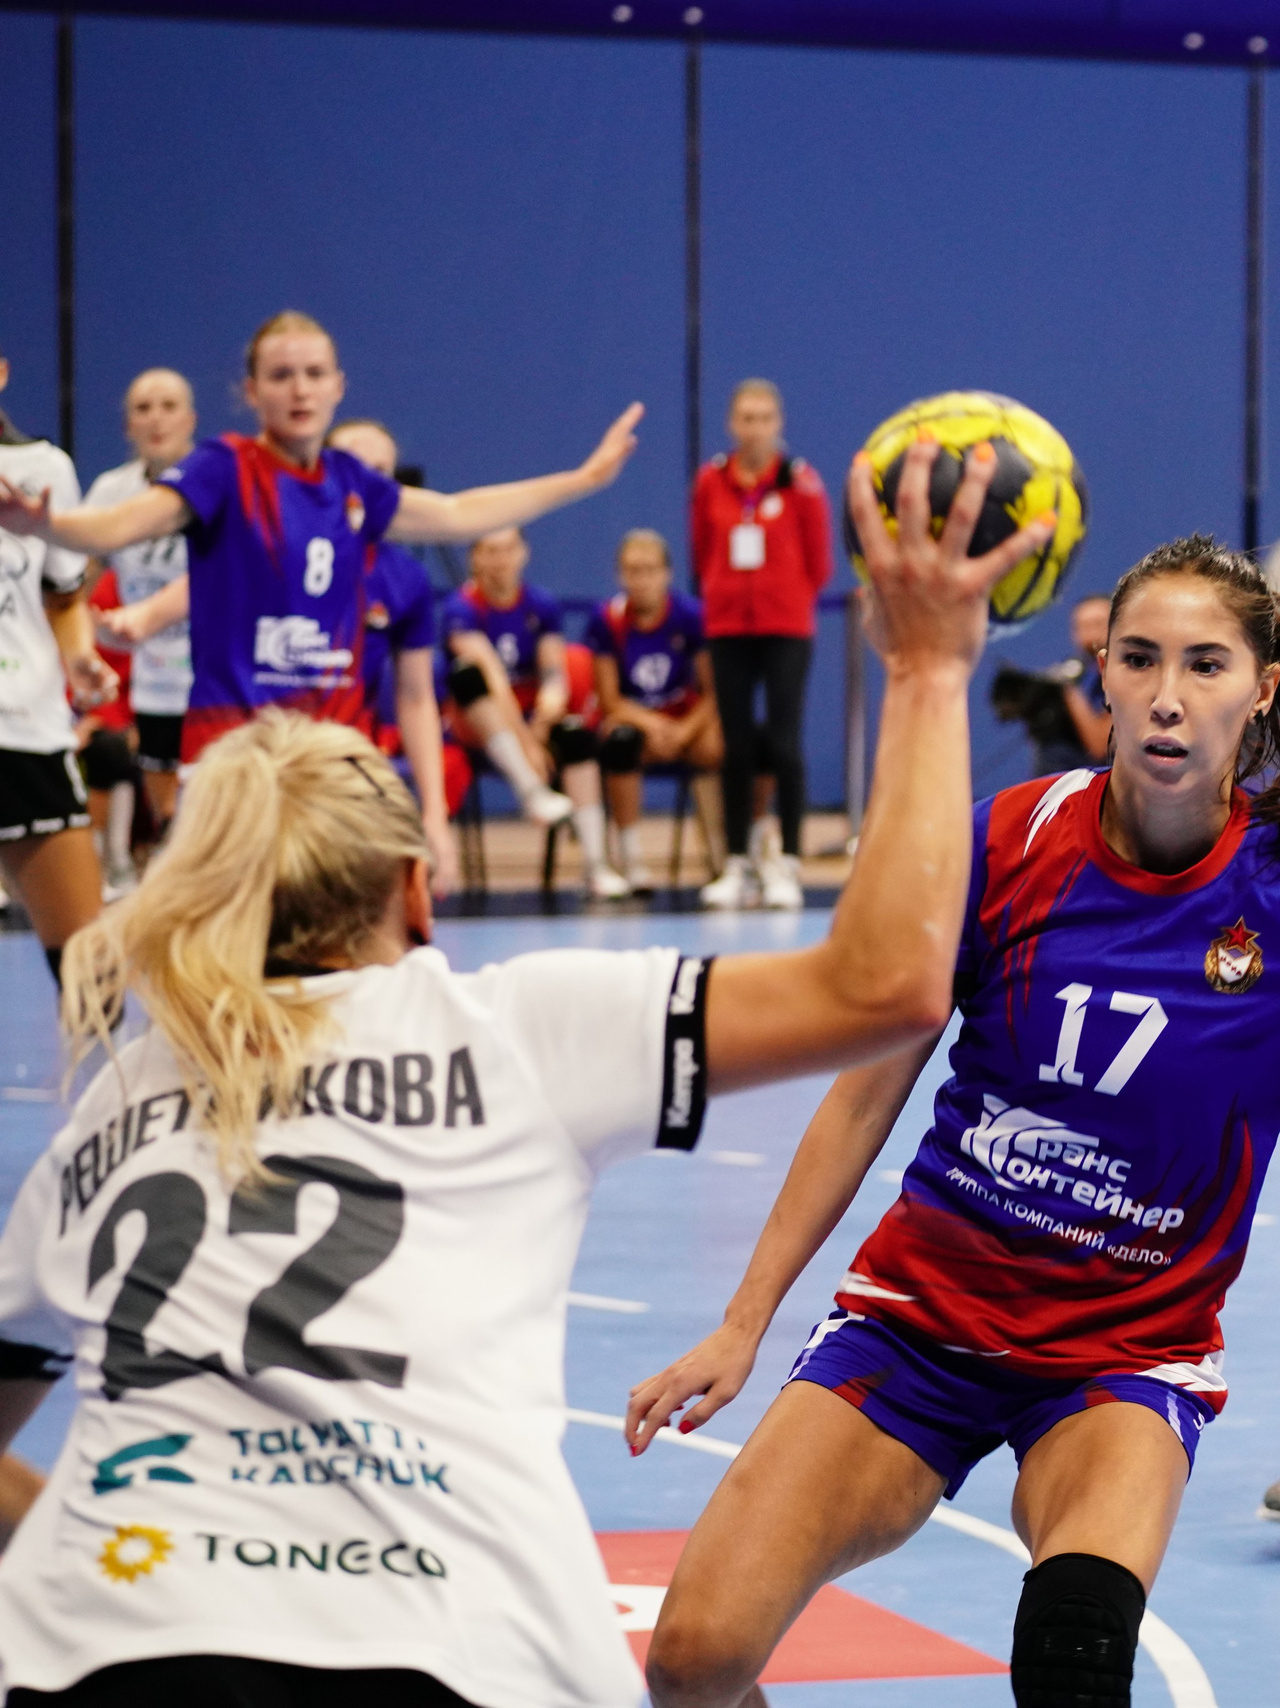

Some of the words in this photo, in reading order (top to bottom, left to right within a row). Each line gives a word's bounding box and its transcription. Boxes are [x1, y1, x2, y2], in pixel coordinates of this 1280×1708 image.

[303, 537, 335, 598] 8
[1039, 982, 1169, 1096] 17
[945, 1165, 1000, 1207] ГРУППА
[1003, 1198, 1107, 1251] КОМПАНИЙ
[1107, 1243, 1172, 1266] «ДЕЛО»
[88, 1154, 408, 1402] 22
